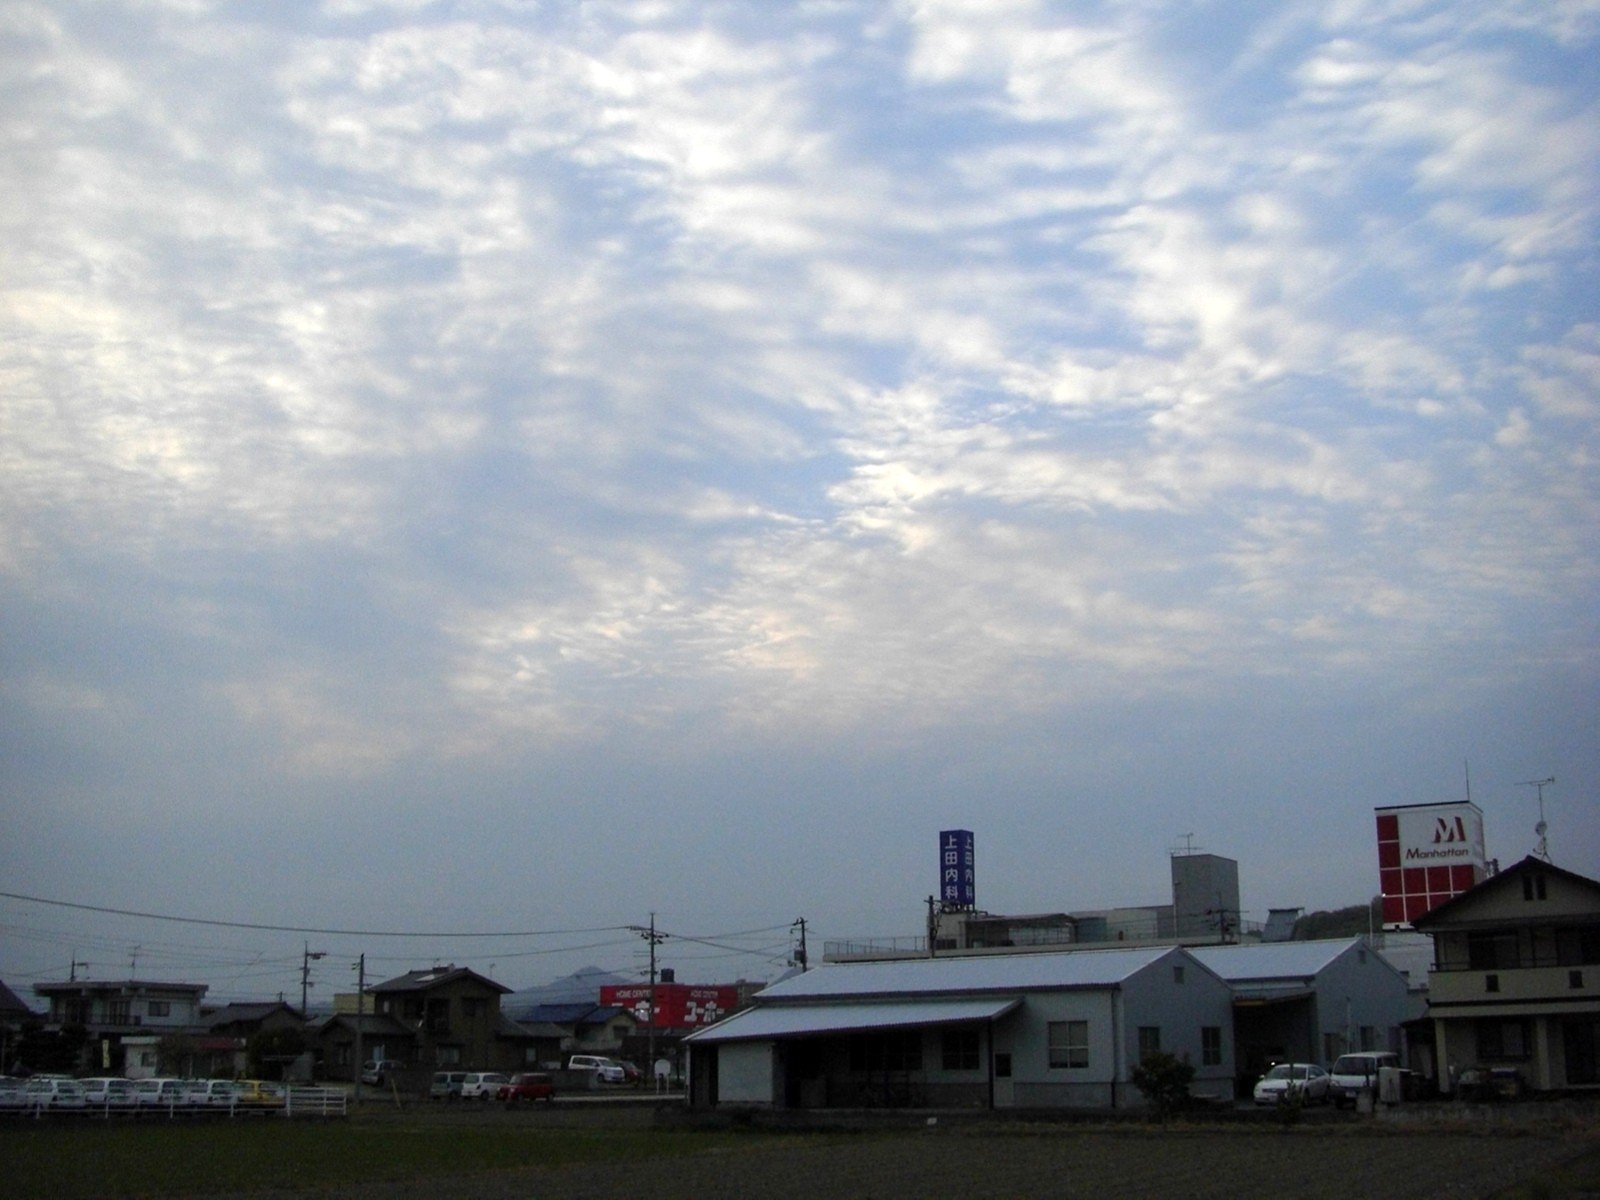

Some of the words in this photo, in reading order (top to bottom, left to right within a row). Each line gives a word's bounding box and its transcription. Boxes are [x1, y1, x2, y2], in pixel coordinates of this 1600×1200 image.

[945, 834, 958, 899] 上田内科
[1406, 847, 1469, 860] Manhattan
